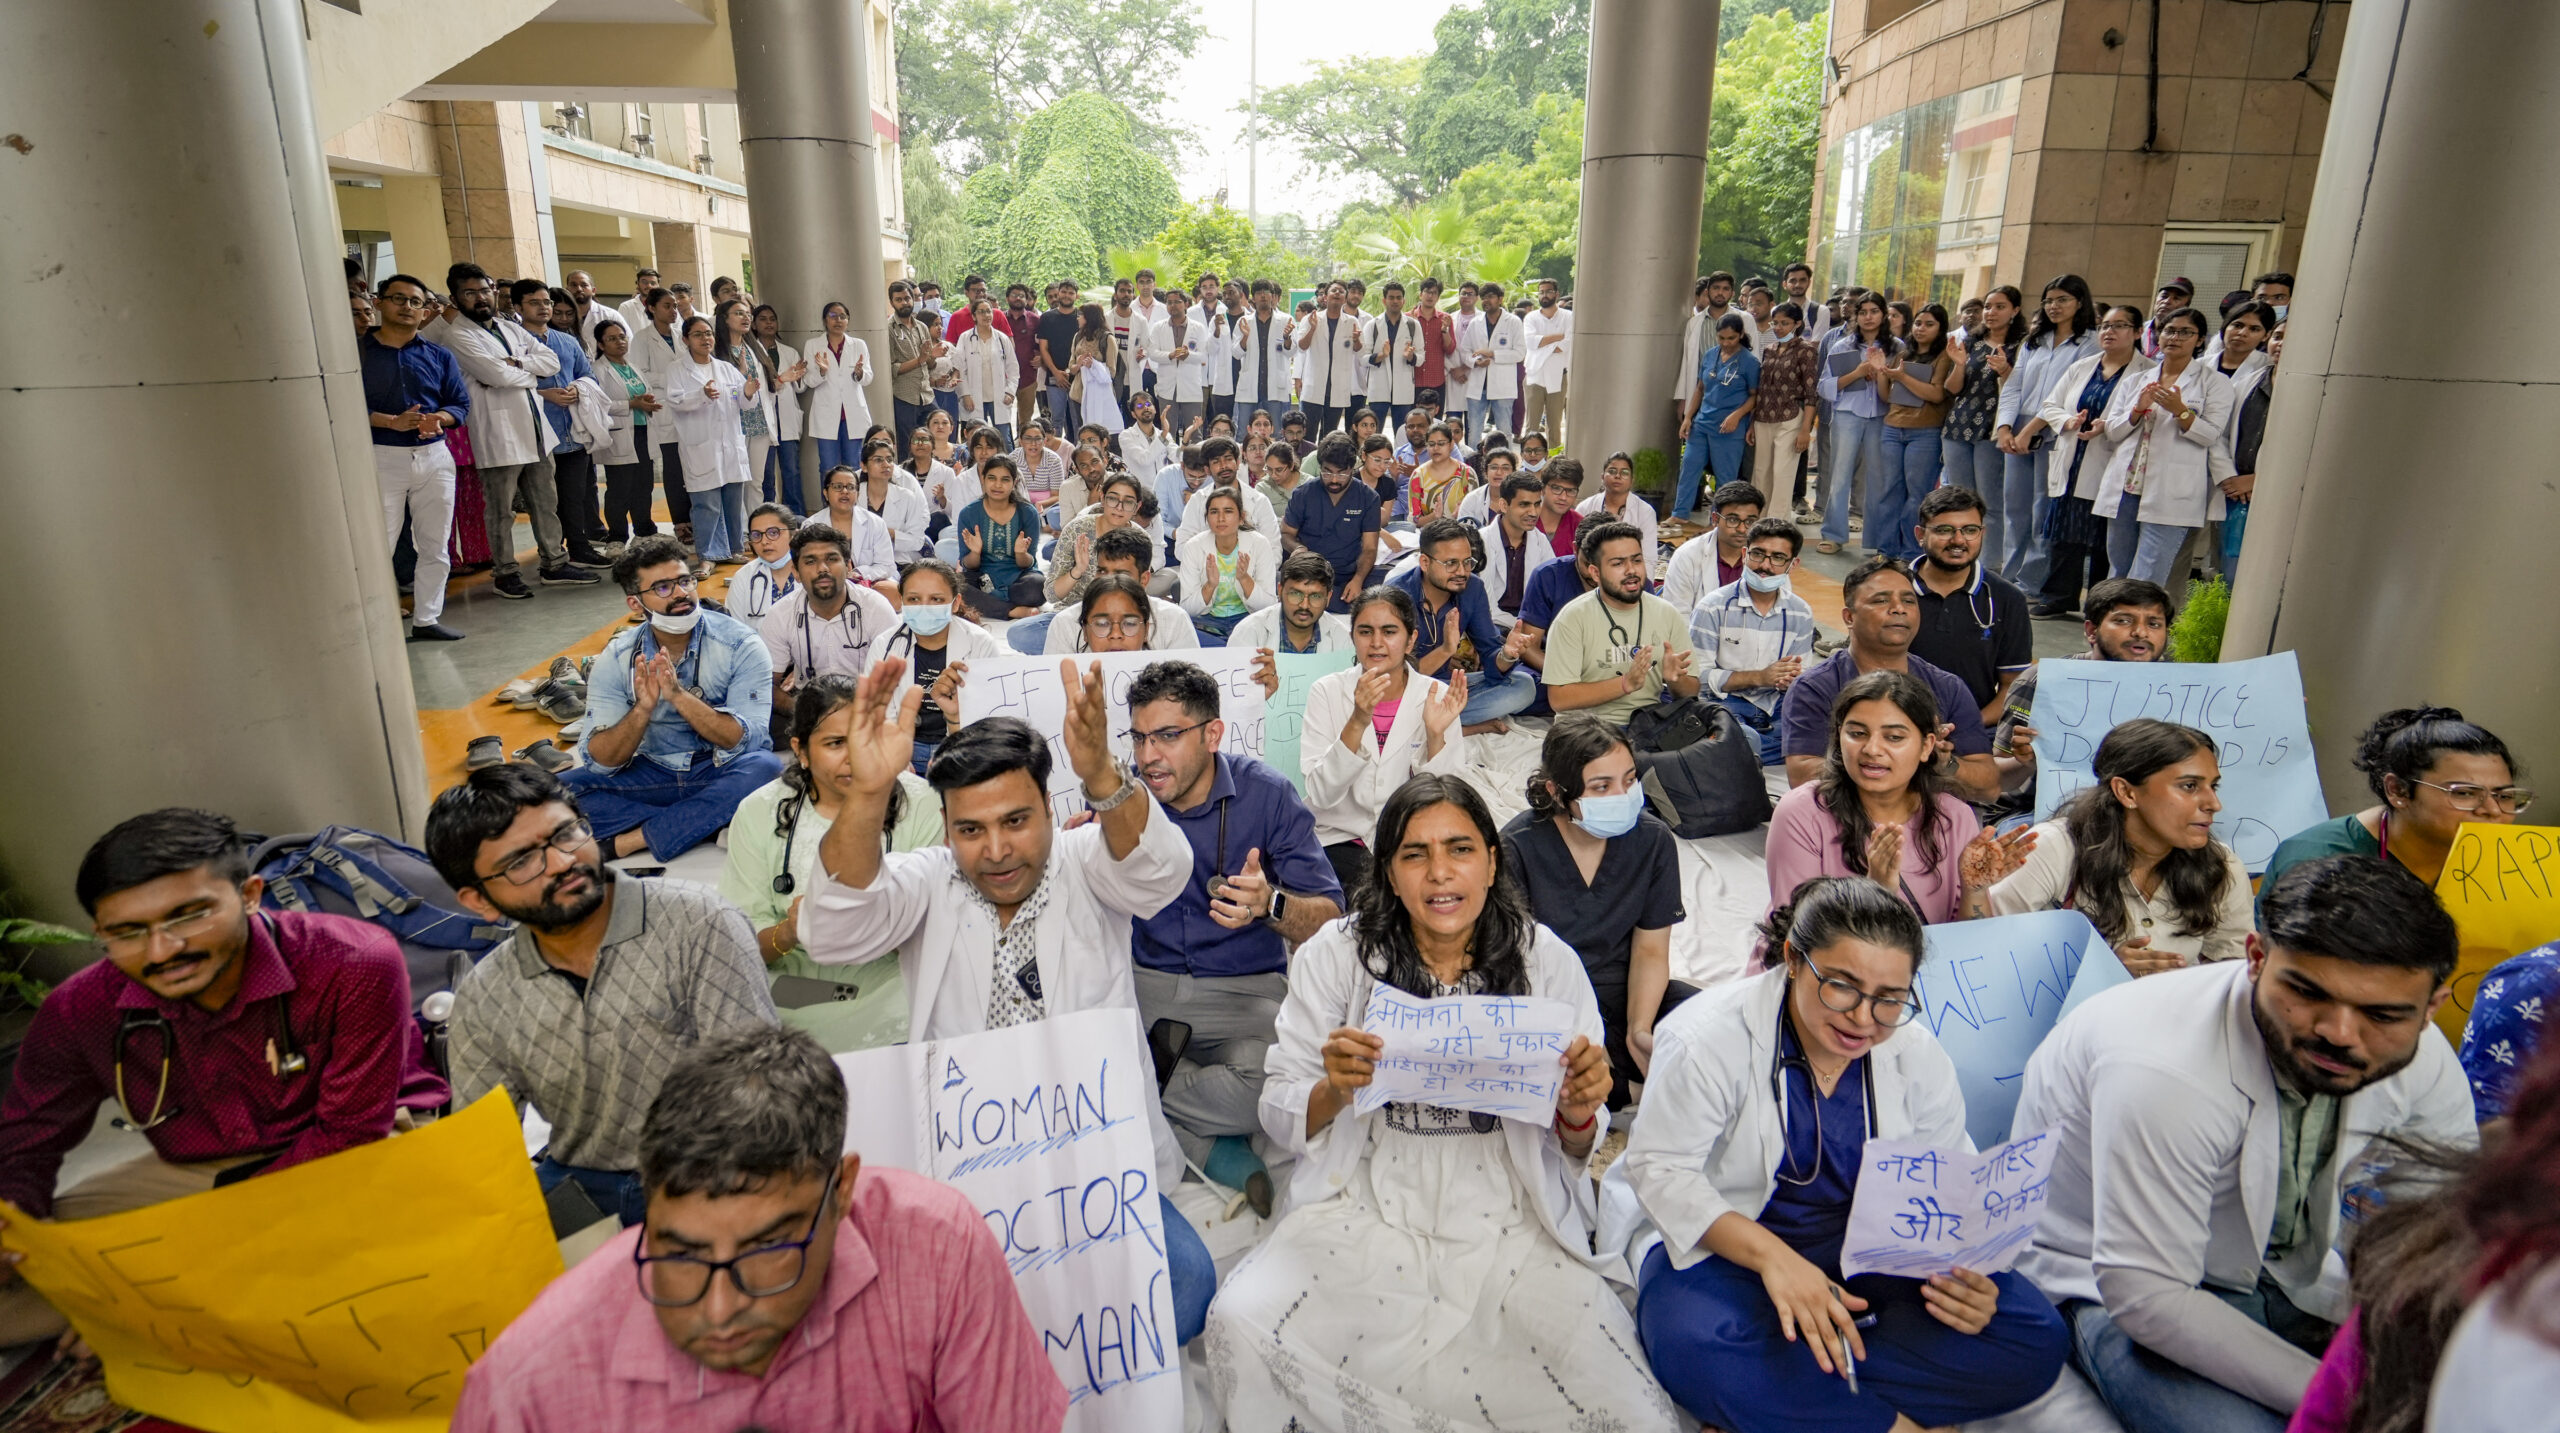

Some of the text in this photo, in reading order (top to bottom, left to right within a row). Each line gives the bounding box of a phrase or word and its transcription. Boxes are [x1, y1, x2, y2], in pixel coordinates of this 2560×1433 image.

[987, 669, 1050, 717] IF
[2056, 677, 2255, 729] JUSTICE
[2258, 736, 2289, 766] IS
[2452, 831, 2560, 904] RAP
[1918, 955, 2007, 1038] WE
[946, 1056, 965, 1080] A
[935, 1058, 1107, 1152] WOMAN
[1890, 1195, 1964, 1242] और
